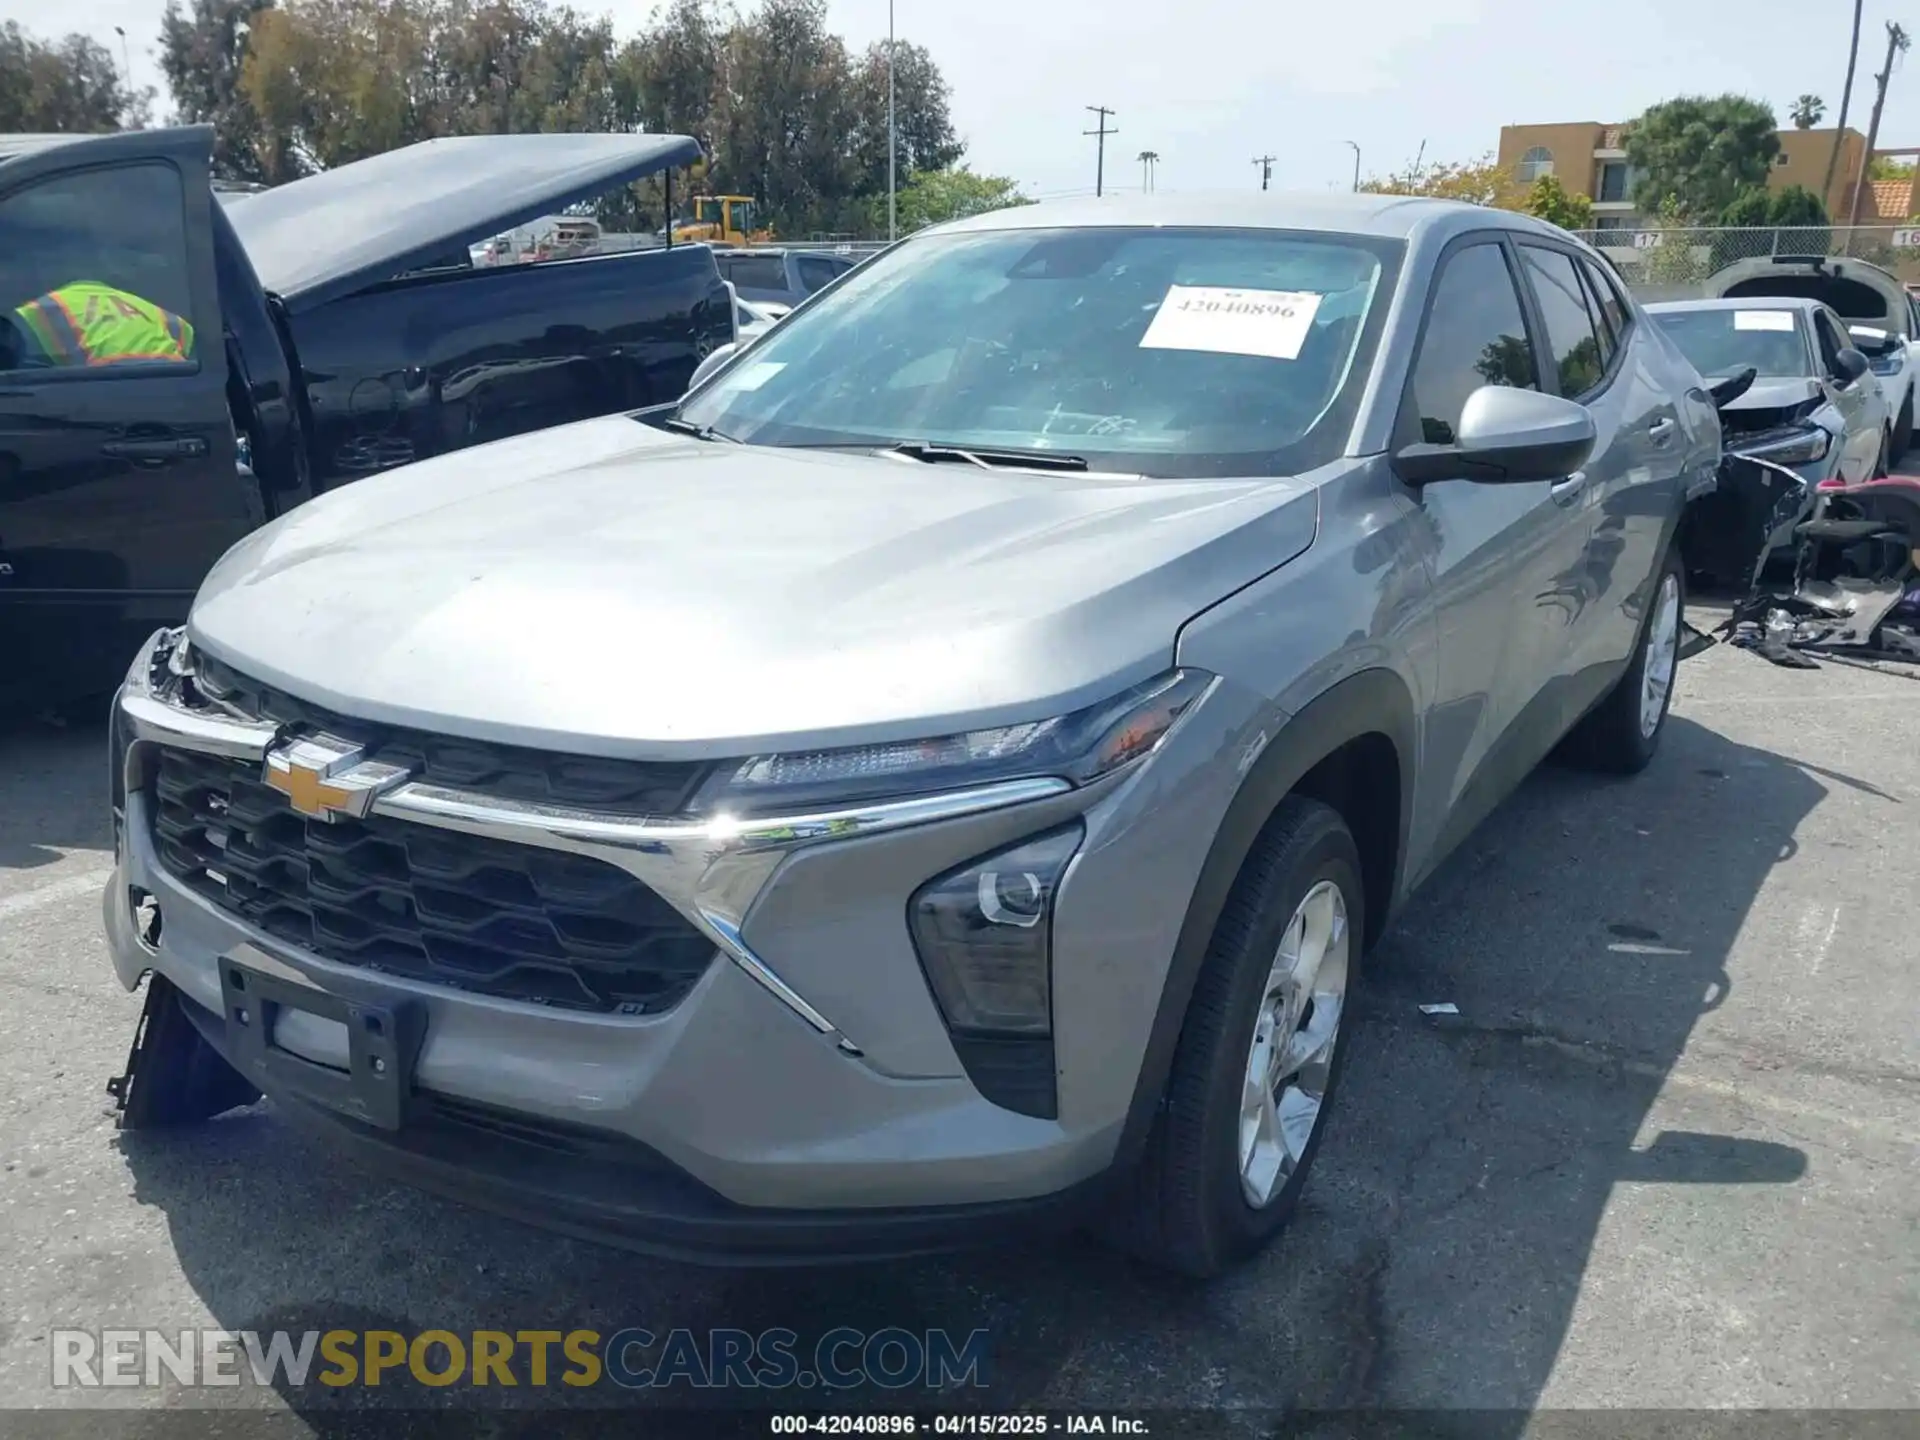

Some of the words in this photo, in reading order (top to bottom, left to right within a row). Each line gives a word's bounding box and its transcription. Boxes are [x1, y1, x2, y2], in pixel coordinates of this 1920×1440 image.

[1641, 233, 1659, 246] 17
[1901, 231, 1920, 244] 16
[1178, 300, 1296, 318] 42040896
